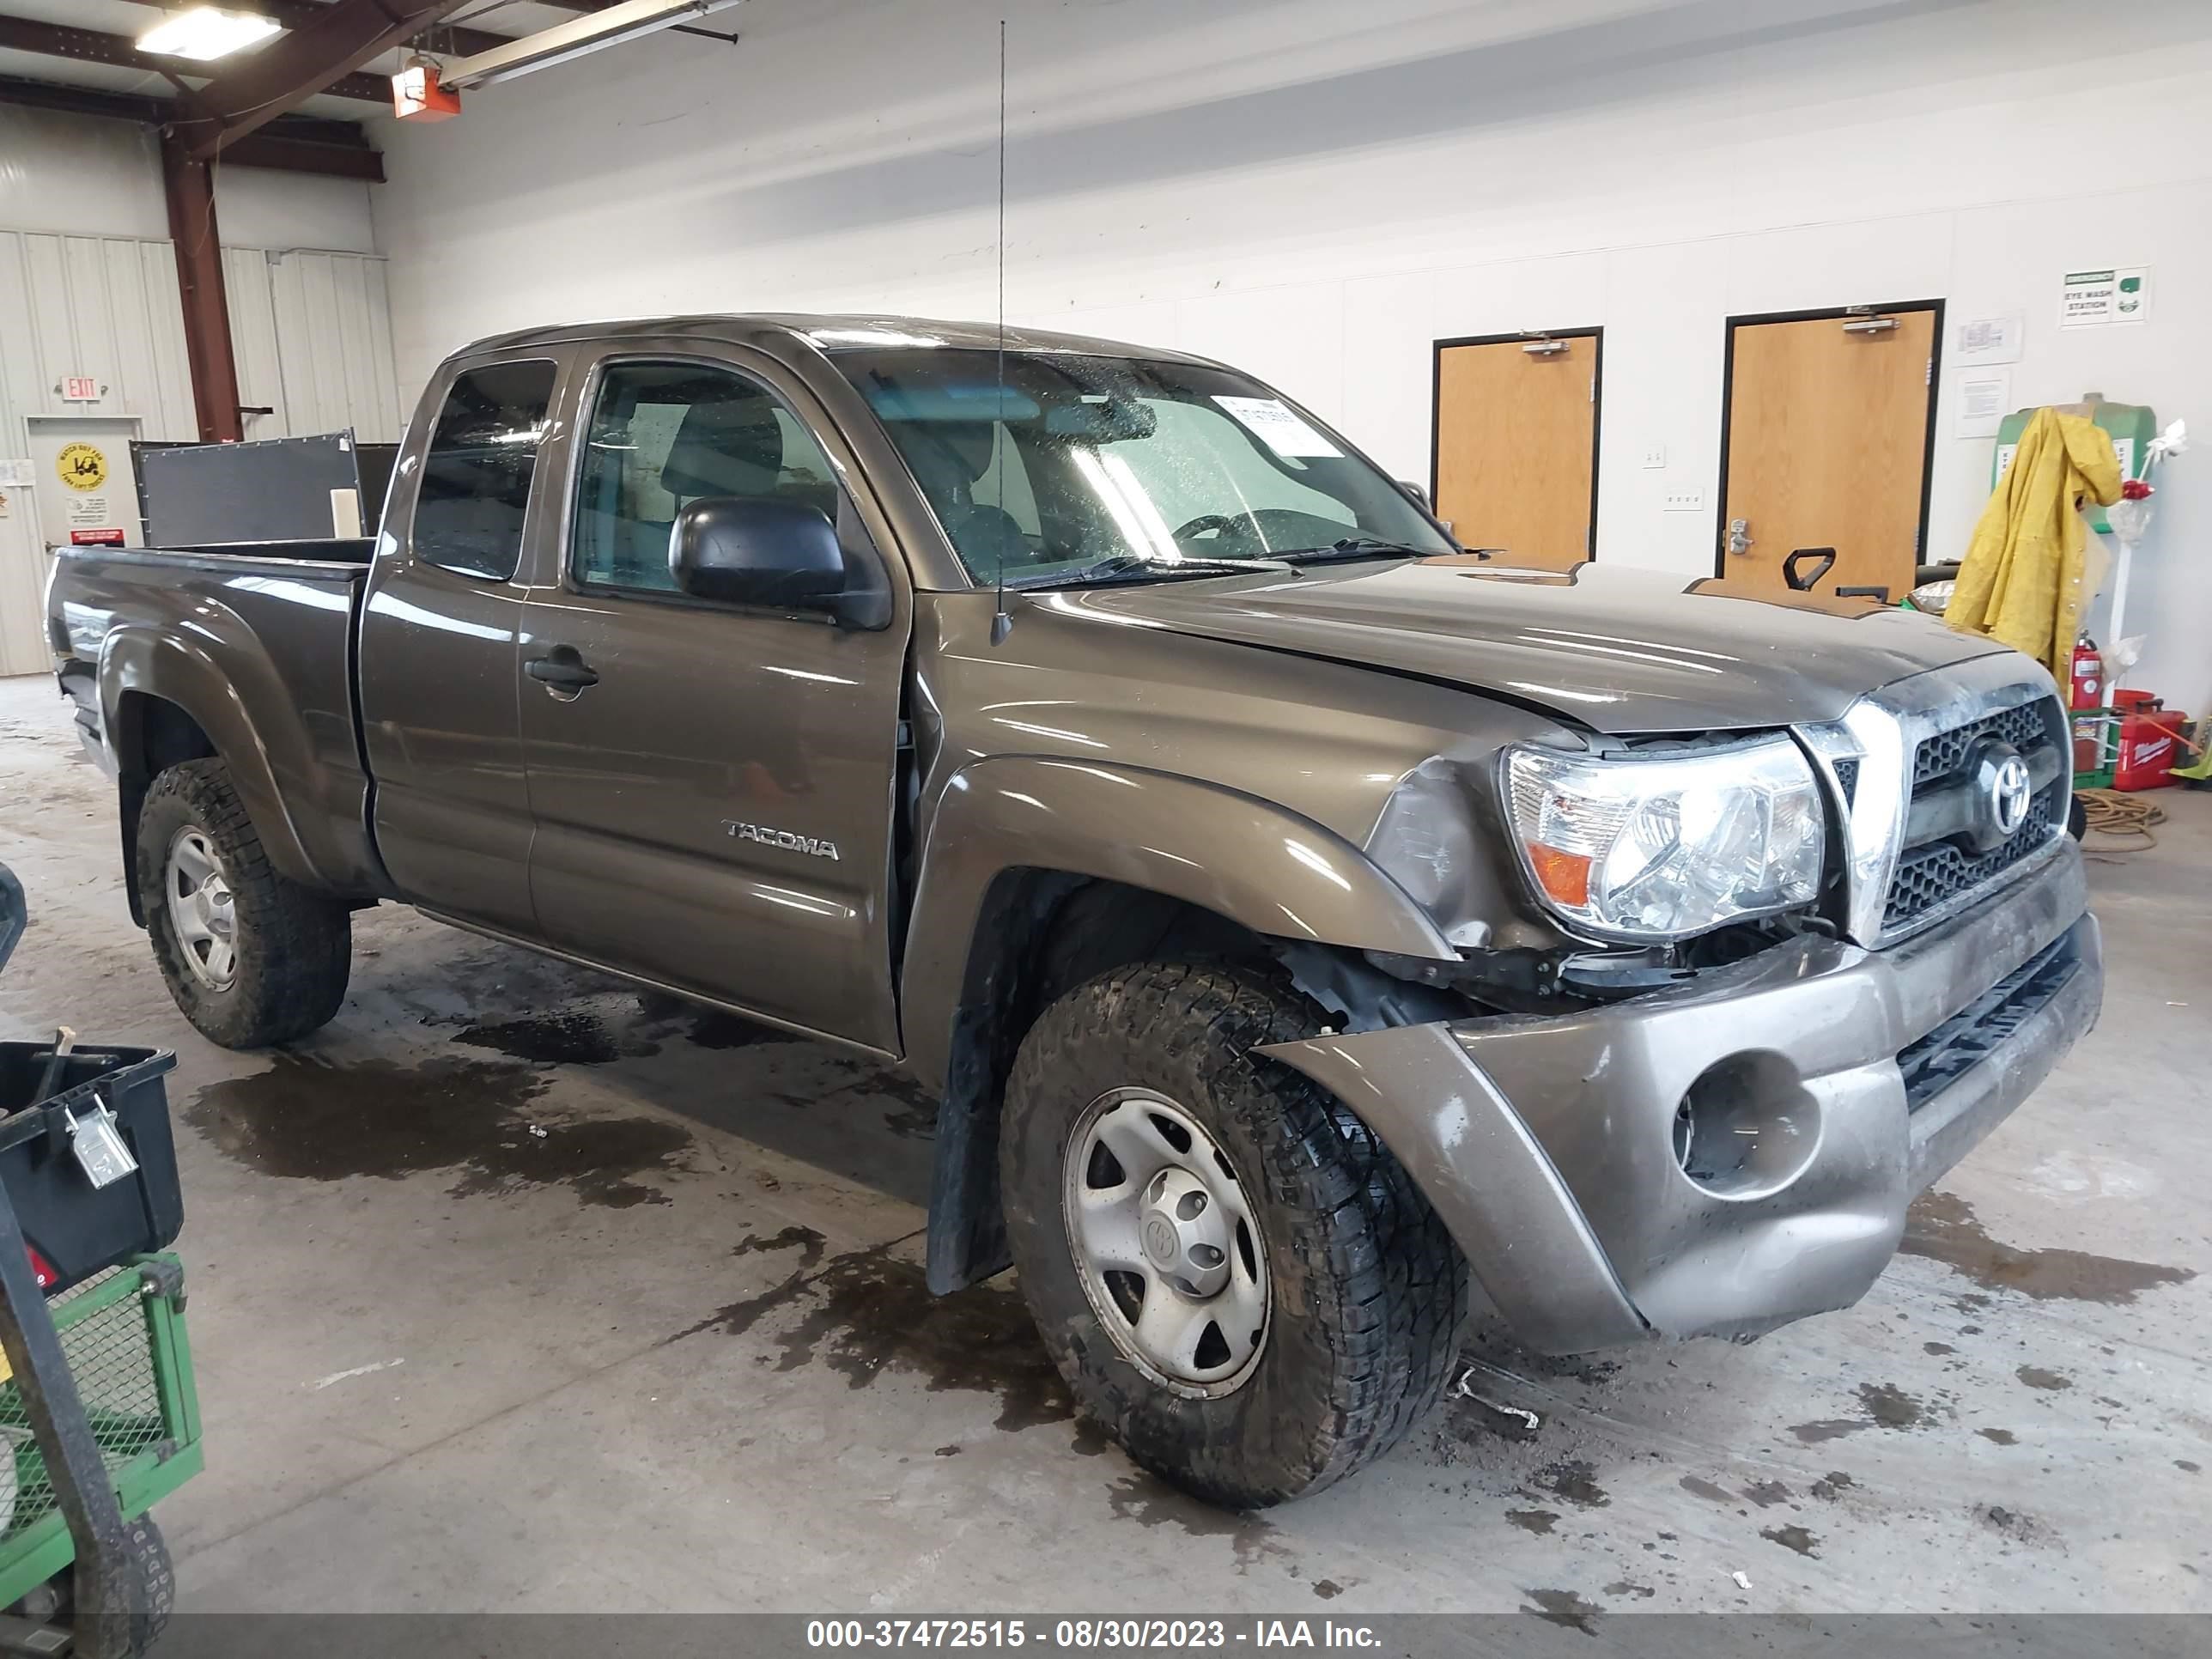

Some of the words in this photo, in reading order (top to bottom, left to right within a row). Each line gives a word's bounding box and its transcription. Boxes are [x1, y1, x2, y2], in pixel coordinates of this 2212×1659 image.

[2064, 292, 2082, 301] EYE
[2068, 301, 2107, 310] STATION
[69, 378, 94, 397] EXIT
[720, 819, 839, 860] TACOMA
